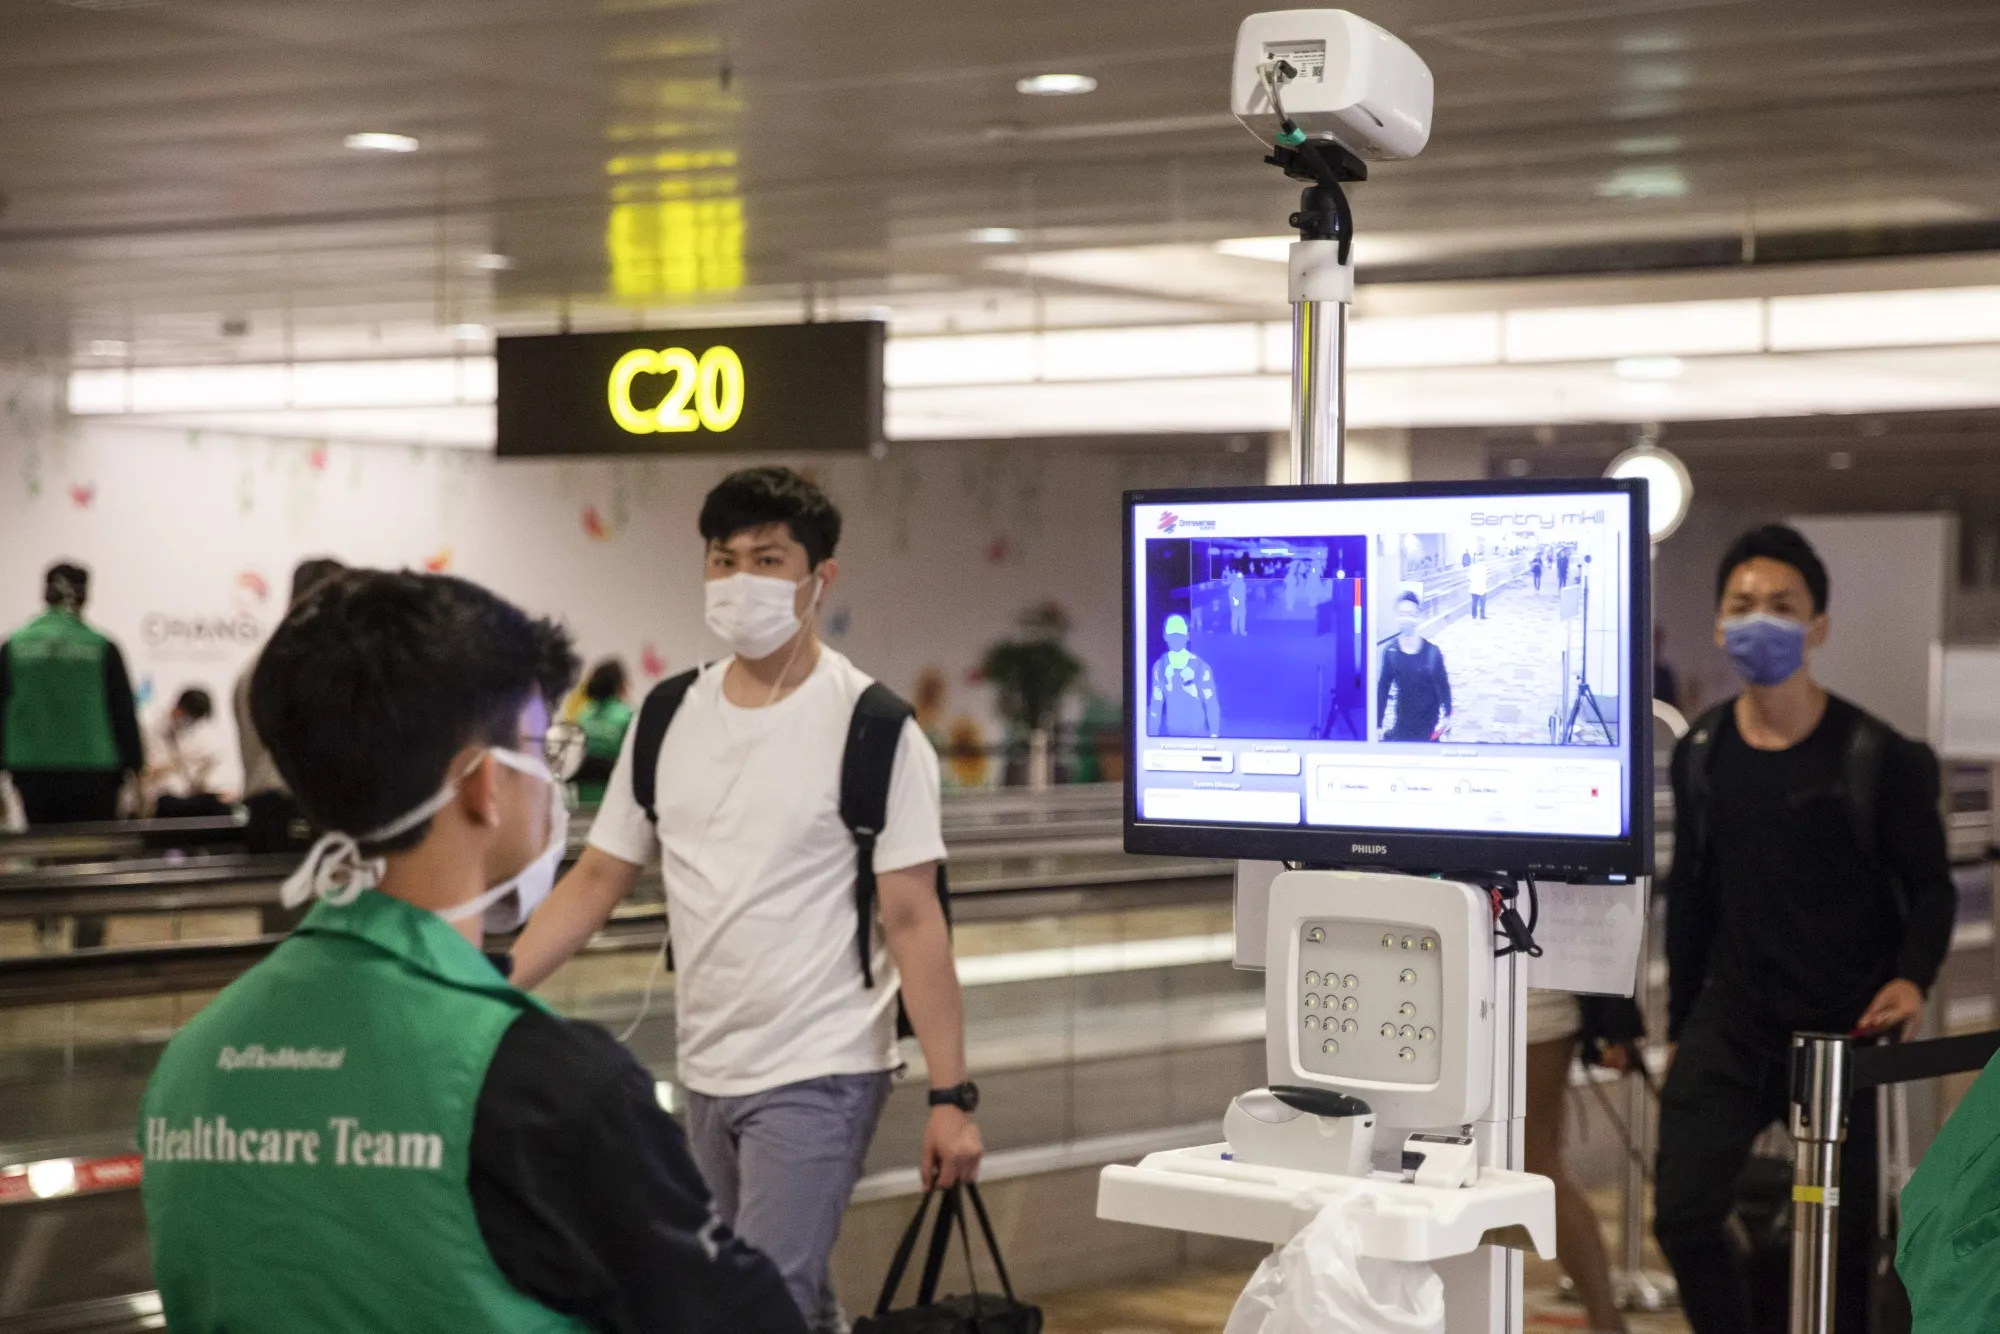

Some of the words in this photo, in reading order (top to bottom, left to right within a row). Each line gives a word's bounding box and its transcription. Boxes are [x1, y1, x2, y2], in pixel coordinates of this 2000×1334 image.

[608, 345, 745, 435] C20
[1470, 512, 1555, 530] Sentry
[1351, 844, 1388, 855] PHILIPS
[1400, 940, 1409, 949] f2
[1420, 942, 1429, 951] f3
[145, 1115, 320, 1165] Healthcare
[328, 1116, 443, 1170] Team
